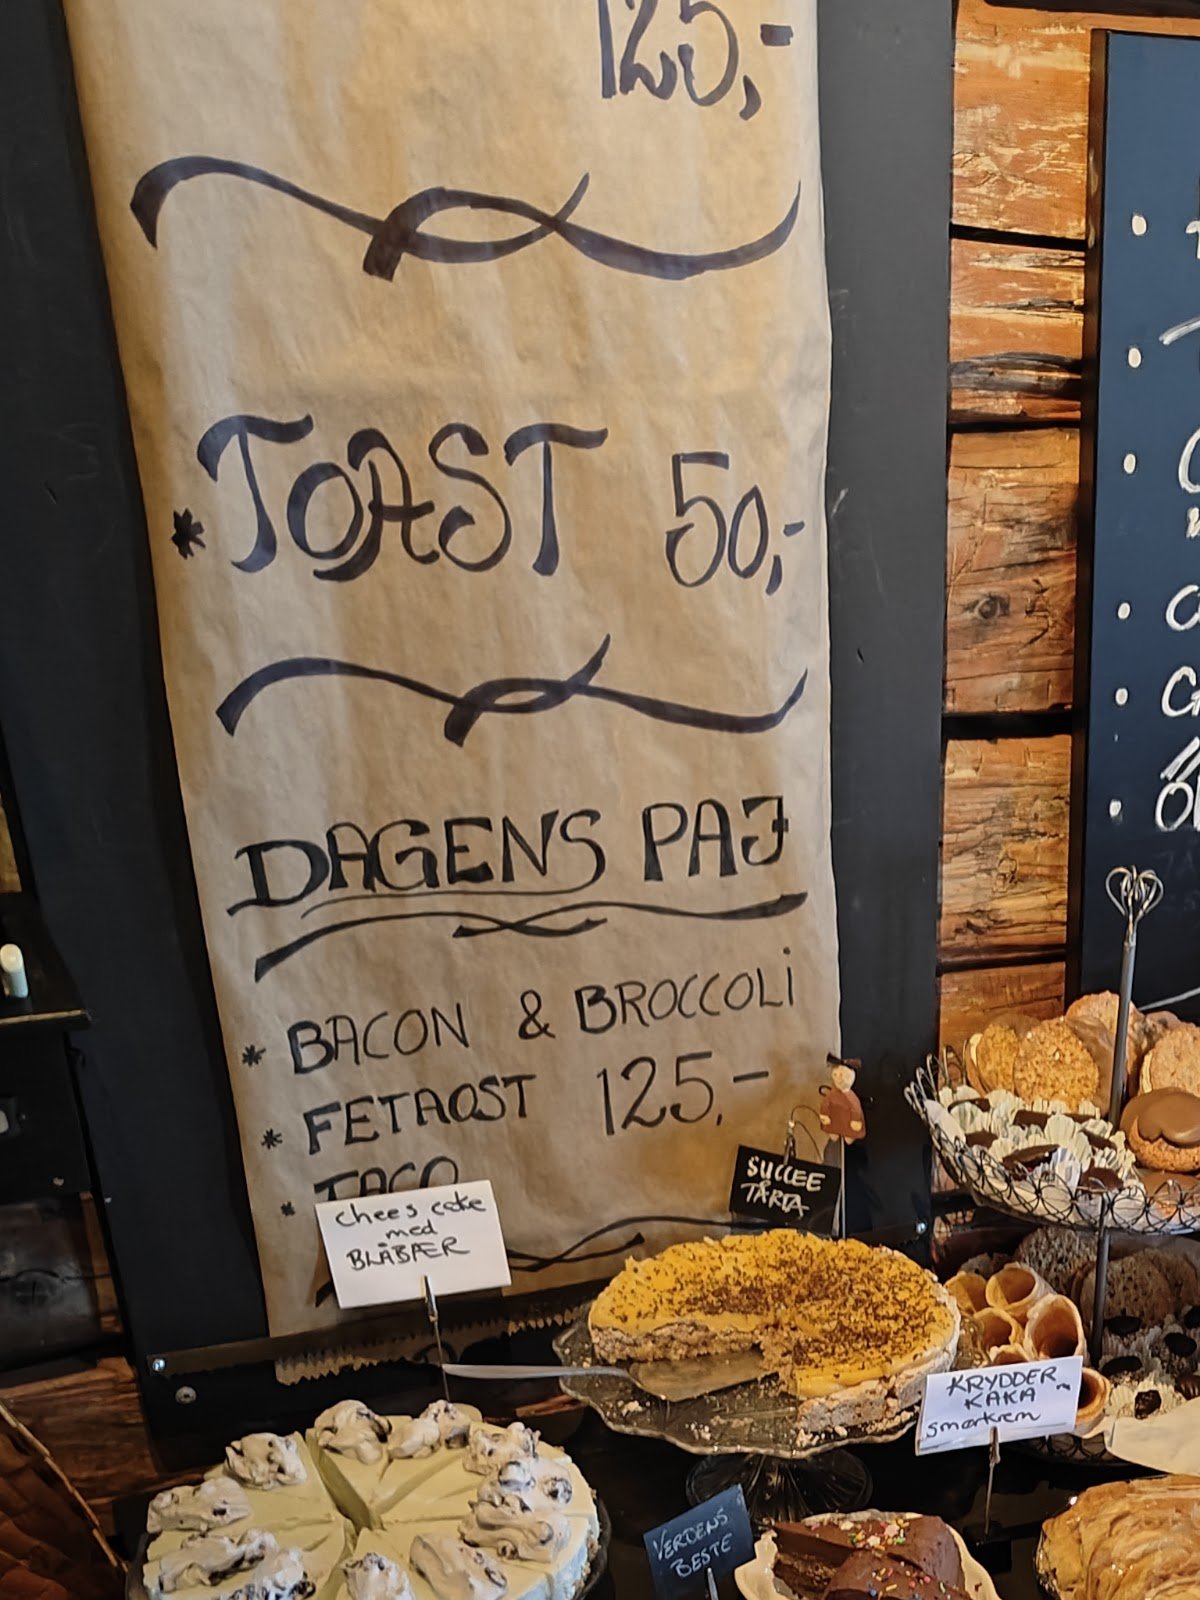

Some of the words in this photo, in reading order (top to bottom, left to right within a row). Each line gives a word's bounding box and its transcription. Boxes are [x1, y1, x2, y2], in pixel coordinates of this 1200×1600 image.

[601, 0, 793, 120] 125,-
[197, 414, 609, 582] TOAST
[666, 451, 805, 595] 50,-
[227, 808, 602, 916] DAGENS
[642, 795, 789, 883] PAJ
[291, 1002, 470, 1075] BACON
[517, 990, 556, 1042] &
[303, 1073, 537, 1155] FETAOST
[747, 1155, 826, 1192] SUCCEE
[386, 1219, 439, 1240] med
[946, 1366, 1058, 1397] KRYDDER
[963, 1387, 1036, 1411] KAKA
[652, 1507, 728, 1561] VERDENS
[669, 1532, 733, 1578] BESTE
